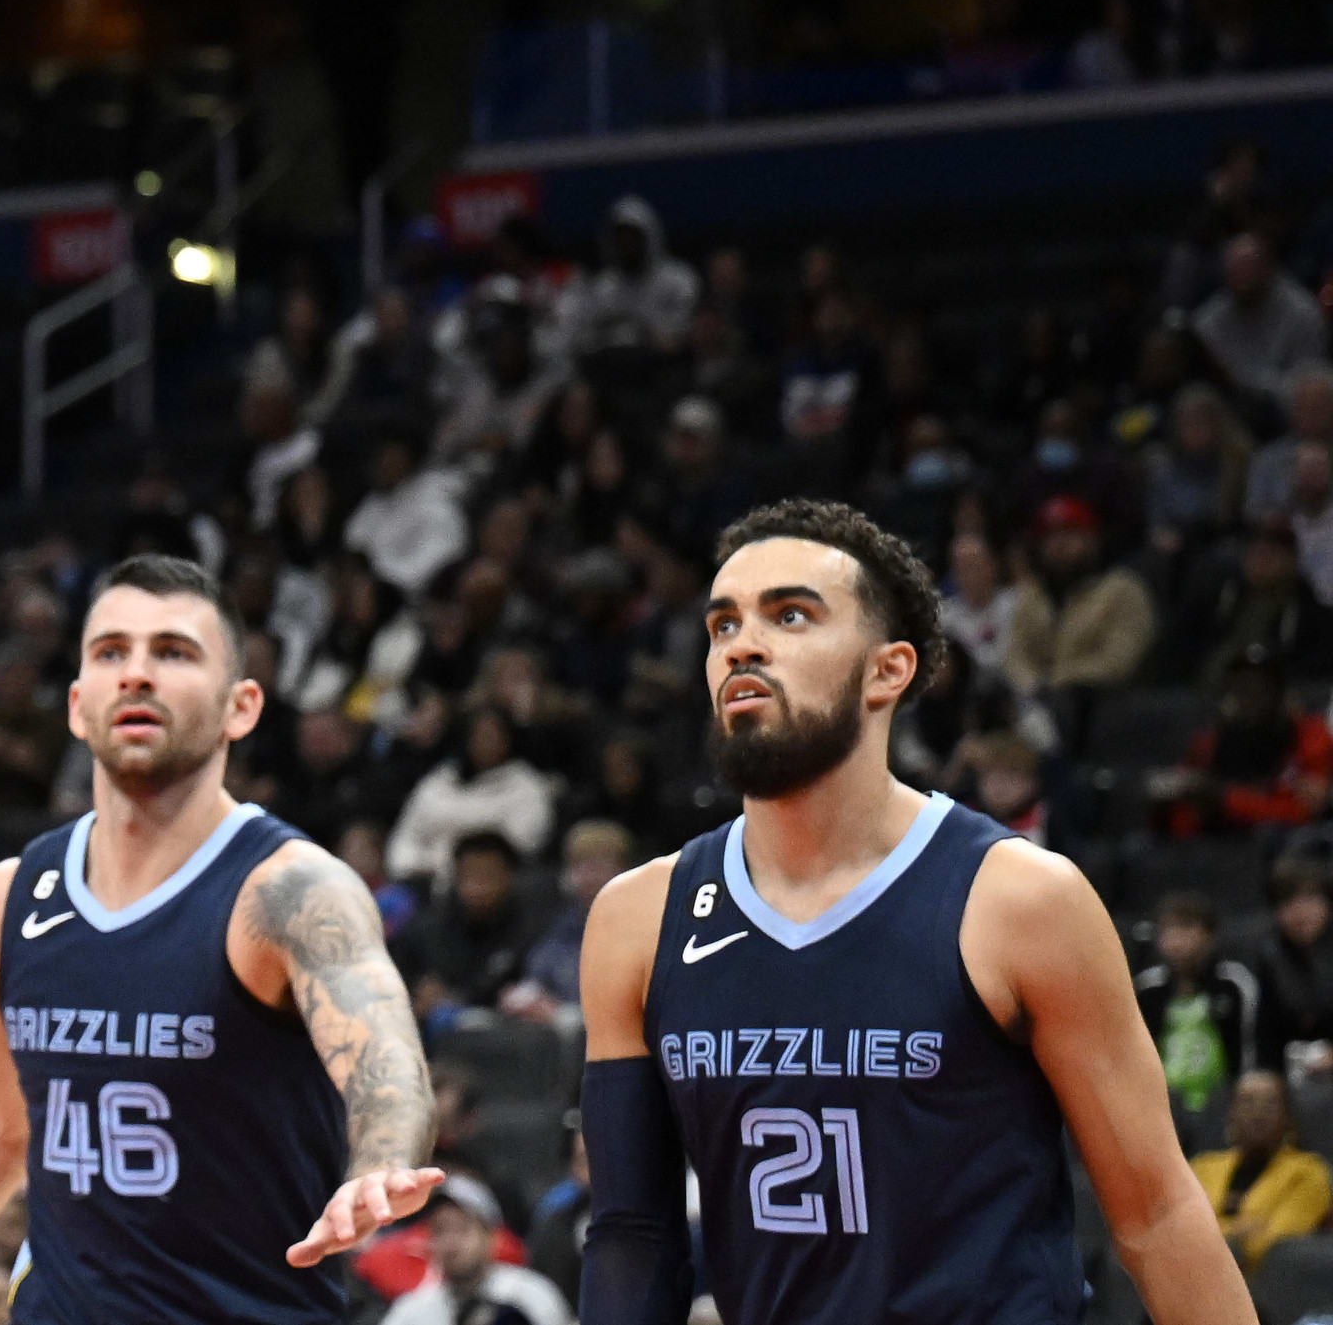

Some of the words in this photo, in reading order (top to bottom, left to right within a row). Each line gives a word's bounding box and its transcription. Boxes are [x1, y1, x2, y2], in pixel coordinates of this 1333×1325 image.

[33, 870, 60, 900] 6
[692, 883, 718, 918] 6
[4, 1005, 217, 1060] GRIZZLIES
[660, 1027, 943, 1082] GRIZZLIES
[42, 1078, 180, 1198] 46
[740, 1106, 870, 1236] 21
